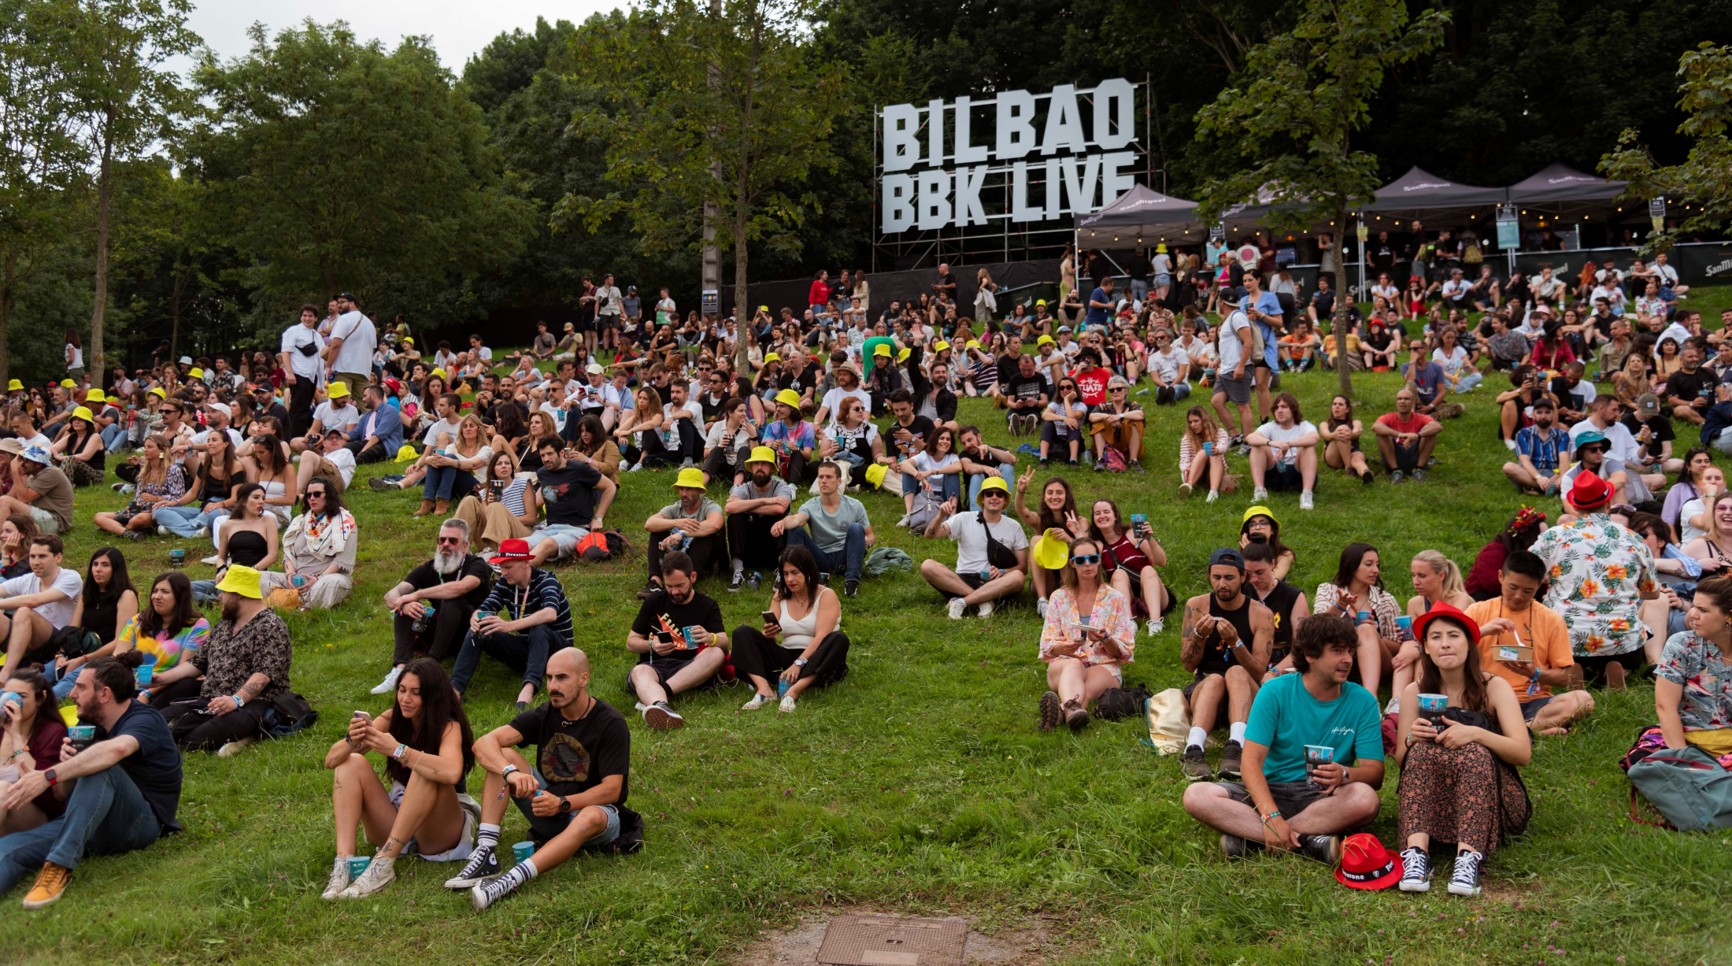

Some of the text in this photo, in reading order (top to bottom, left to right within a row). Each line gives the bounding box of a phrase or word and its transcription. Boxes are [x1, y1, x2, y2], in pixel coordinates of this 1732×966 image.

[882, 77, 1136, 172] BILBAO
[882, 151, 1135, 234] BBK LIVE
